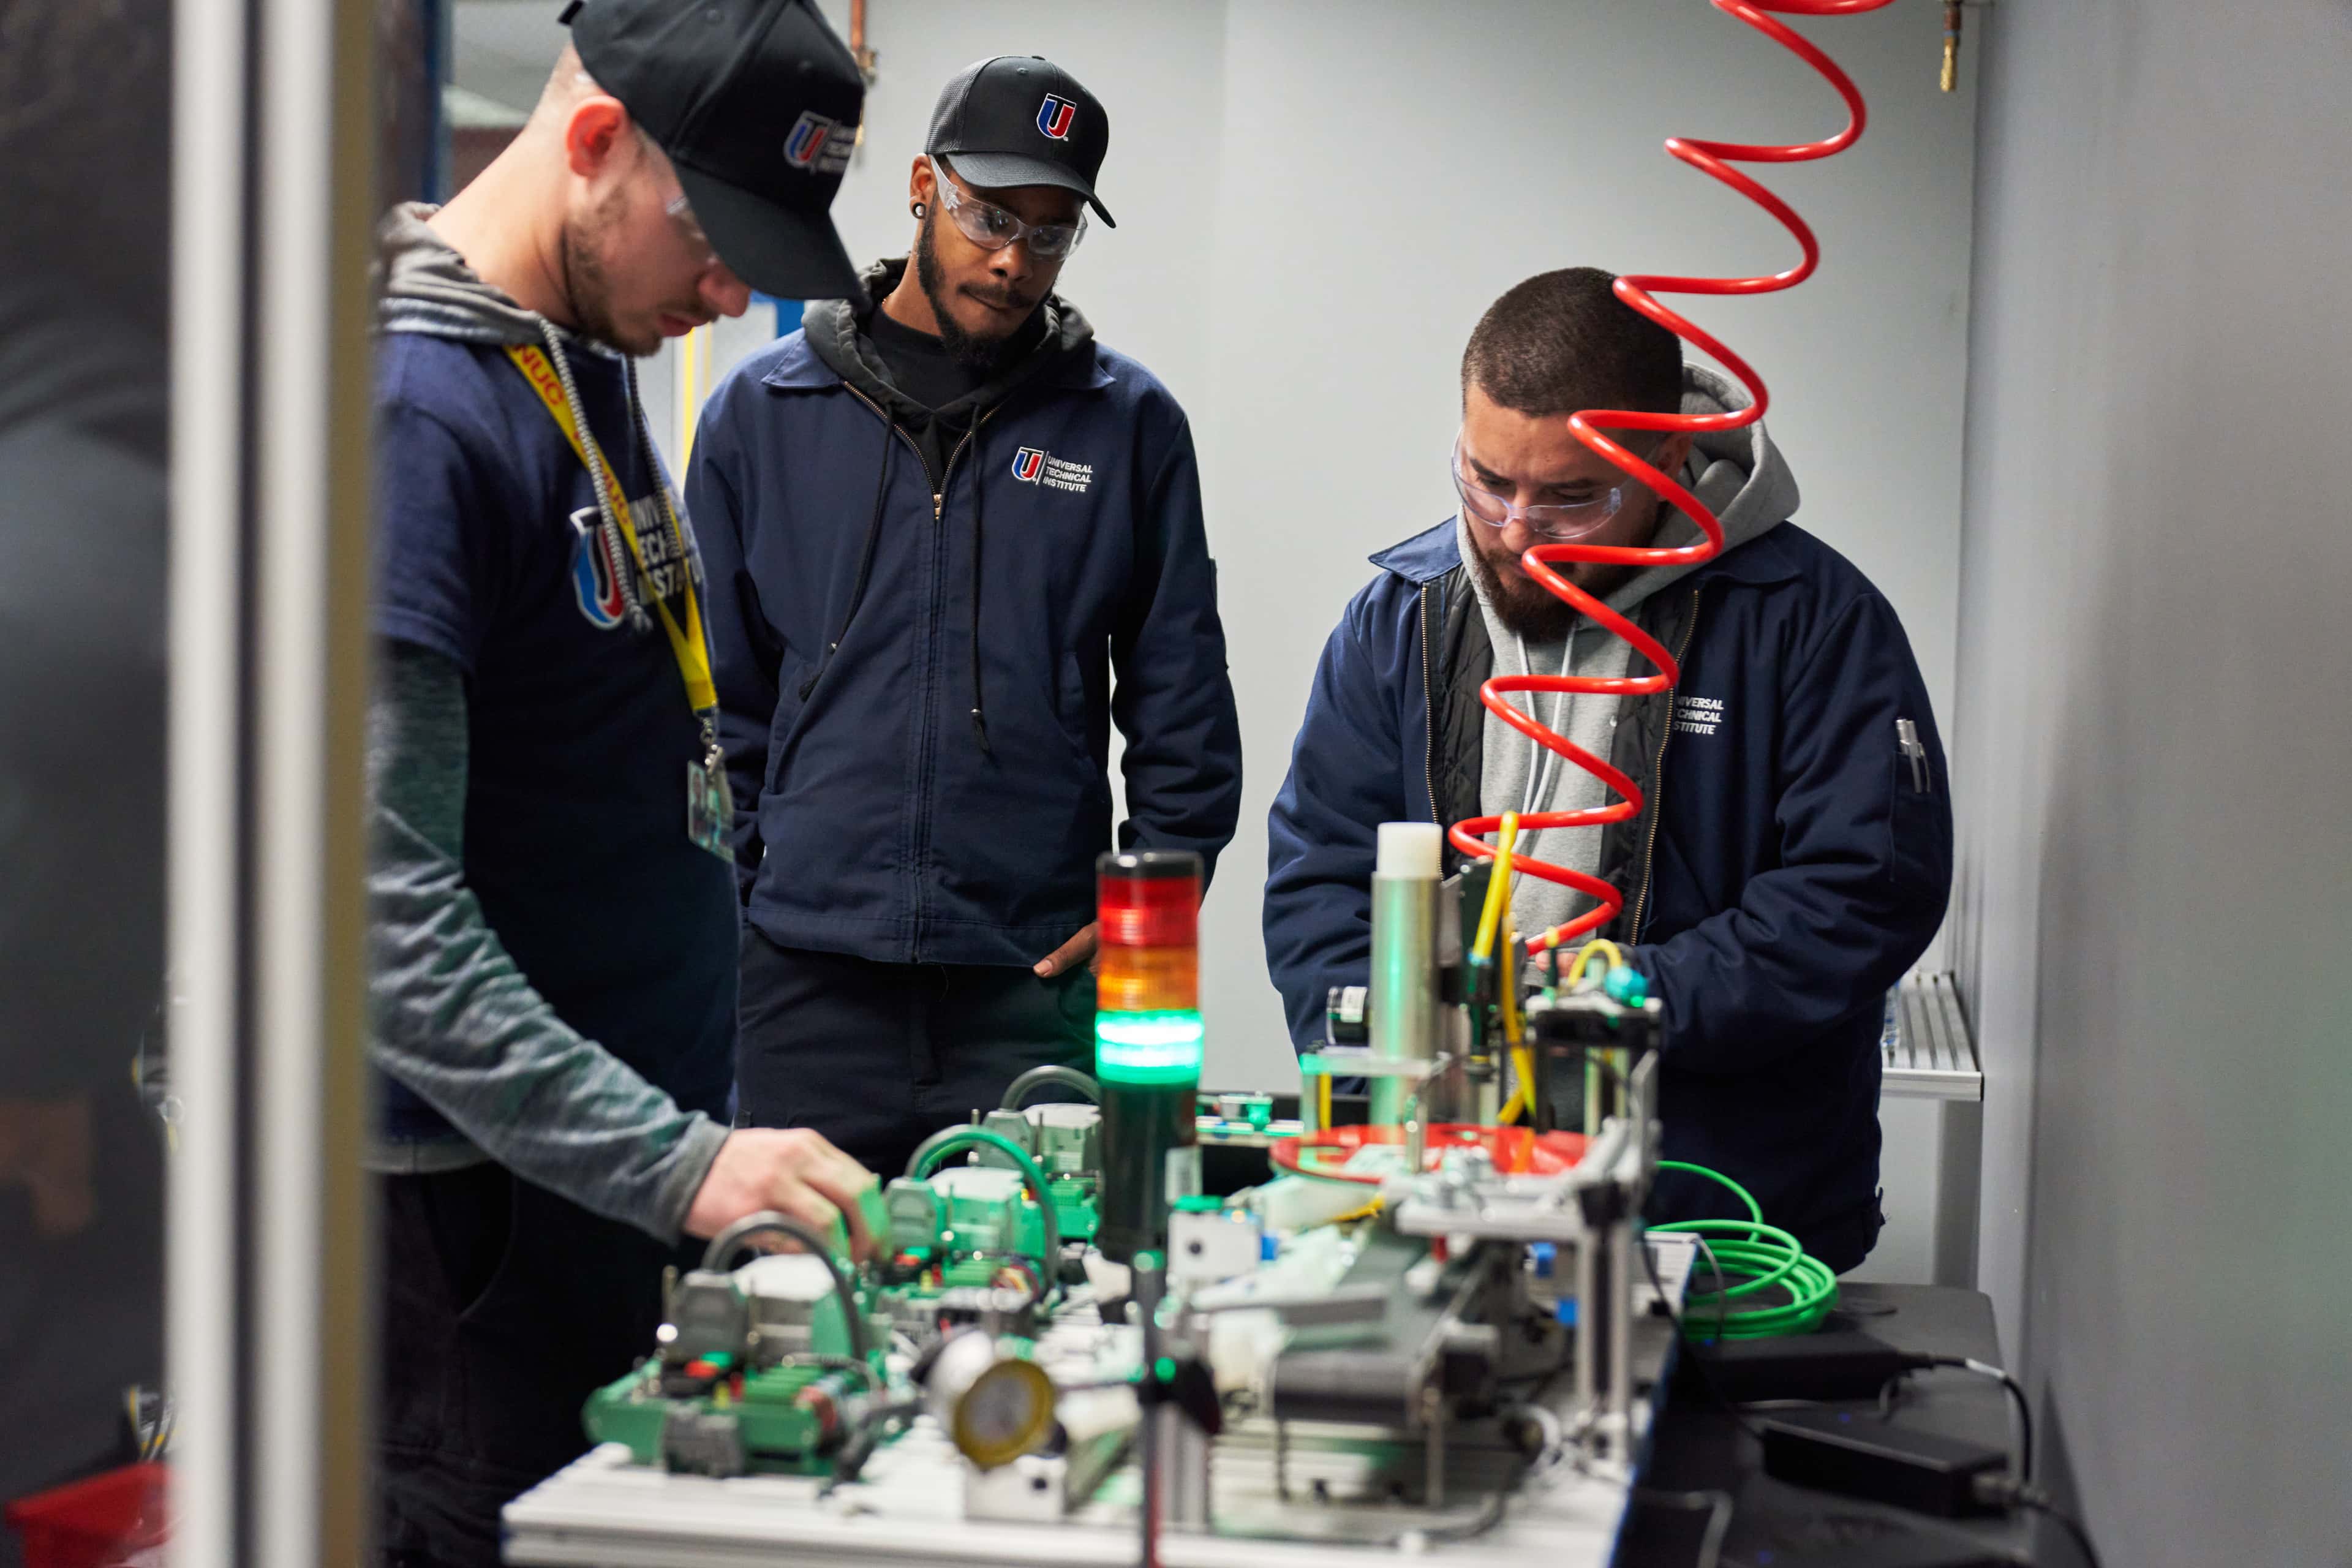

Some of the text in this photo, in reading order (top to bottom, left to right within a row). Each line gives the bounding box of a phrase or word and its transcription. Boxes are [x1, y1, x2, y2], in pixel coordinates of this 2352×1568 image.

[513, 343, 565, 406] NUC
[1047, 456, 1093, 473] UNIVERSAL
[1045, 466, 1091, 483] TECHNICAL
[1042, 476, 1087, 492] INSTITUTE
[1678, 696, 1724, 710] NIVERSAL
[1676, 708, 1722, 723] CHNICAL
[1673, 721, 1717, 735] STITUTE
